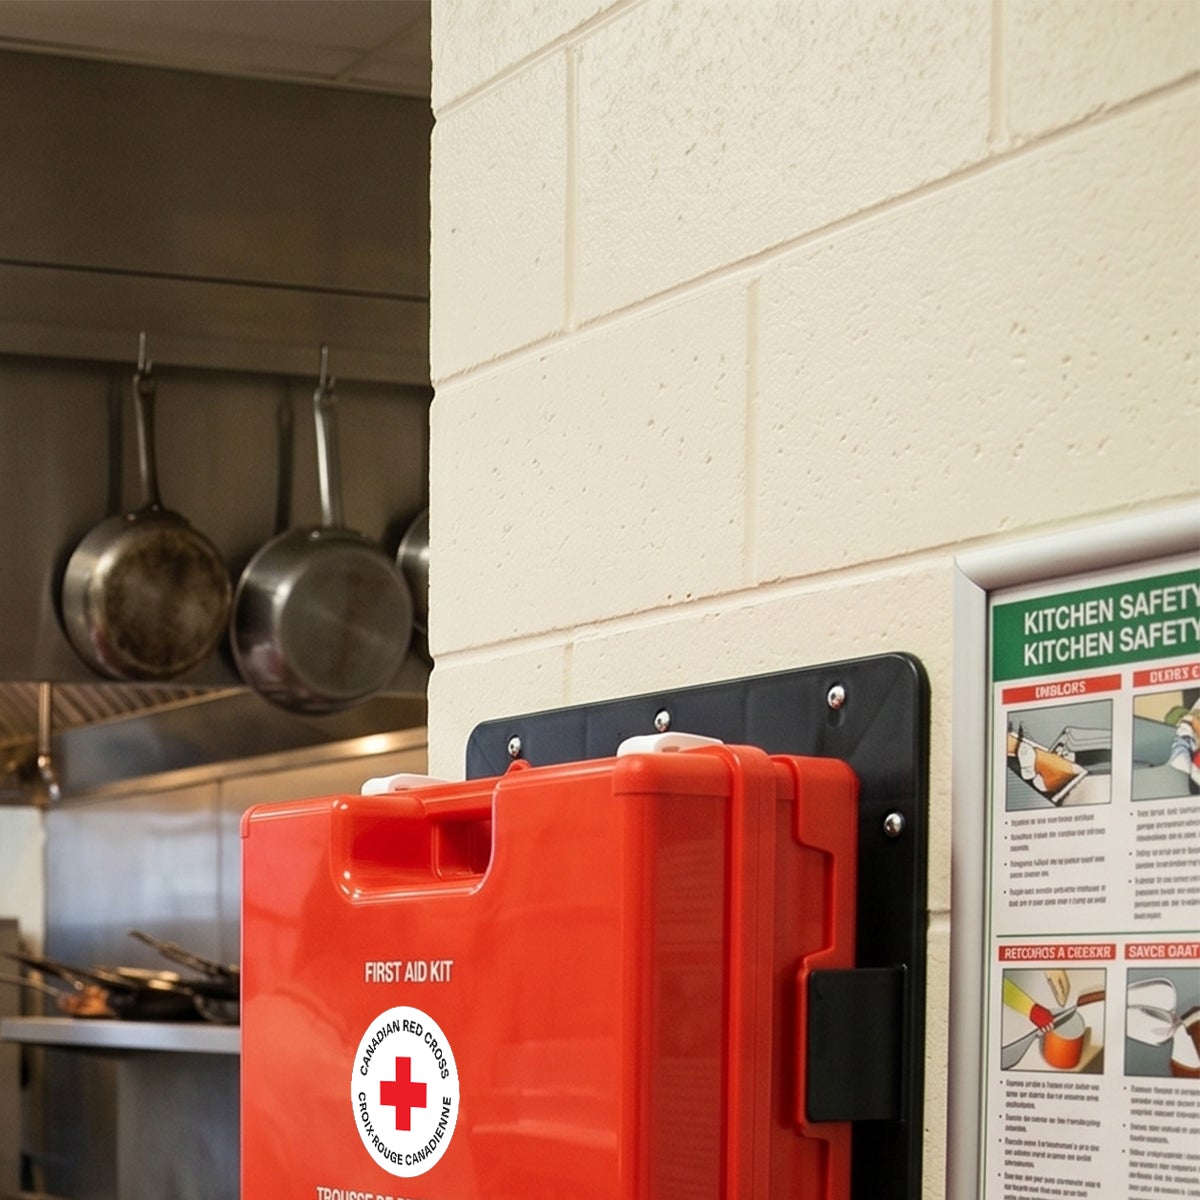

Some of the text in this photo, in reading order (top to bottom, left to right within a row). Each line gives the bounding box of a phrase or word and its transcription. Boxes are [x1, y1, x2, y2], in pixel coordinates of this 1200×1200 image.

[1024, 582, 1200, 636] KITCHEN SAFETY
[1024, 616, 1200, 667] KITCHEN SAFETY
[364, 959, 454, 983] FIRST AID KIT
[359, 1019, 450, 1079] CANADIAN RED CROSS
[358, 1091, 452, 1166] CROIX-ROUGE CANADIENNE
